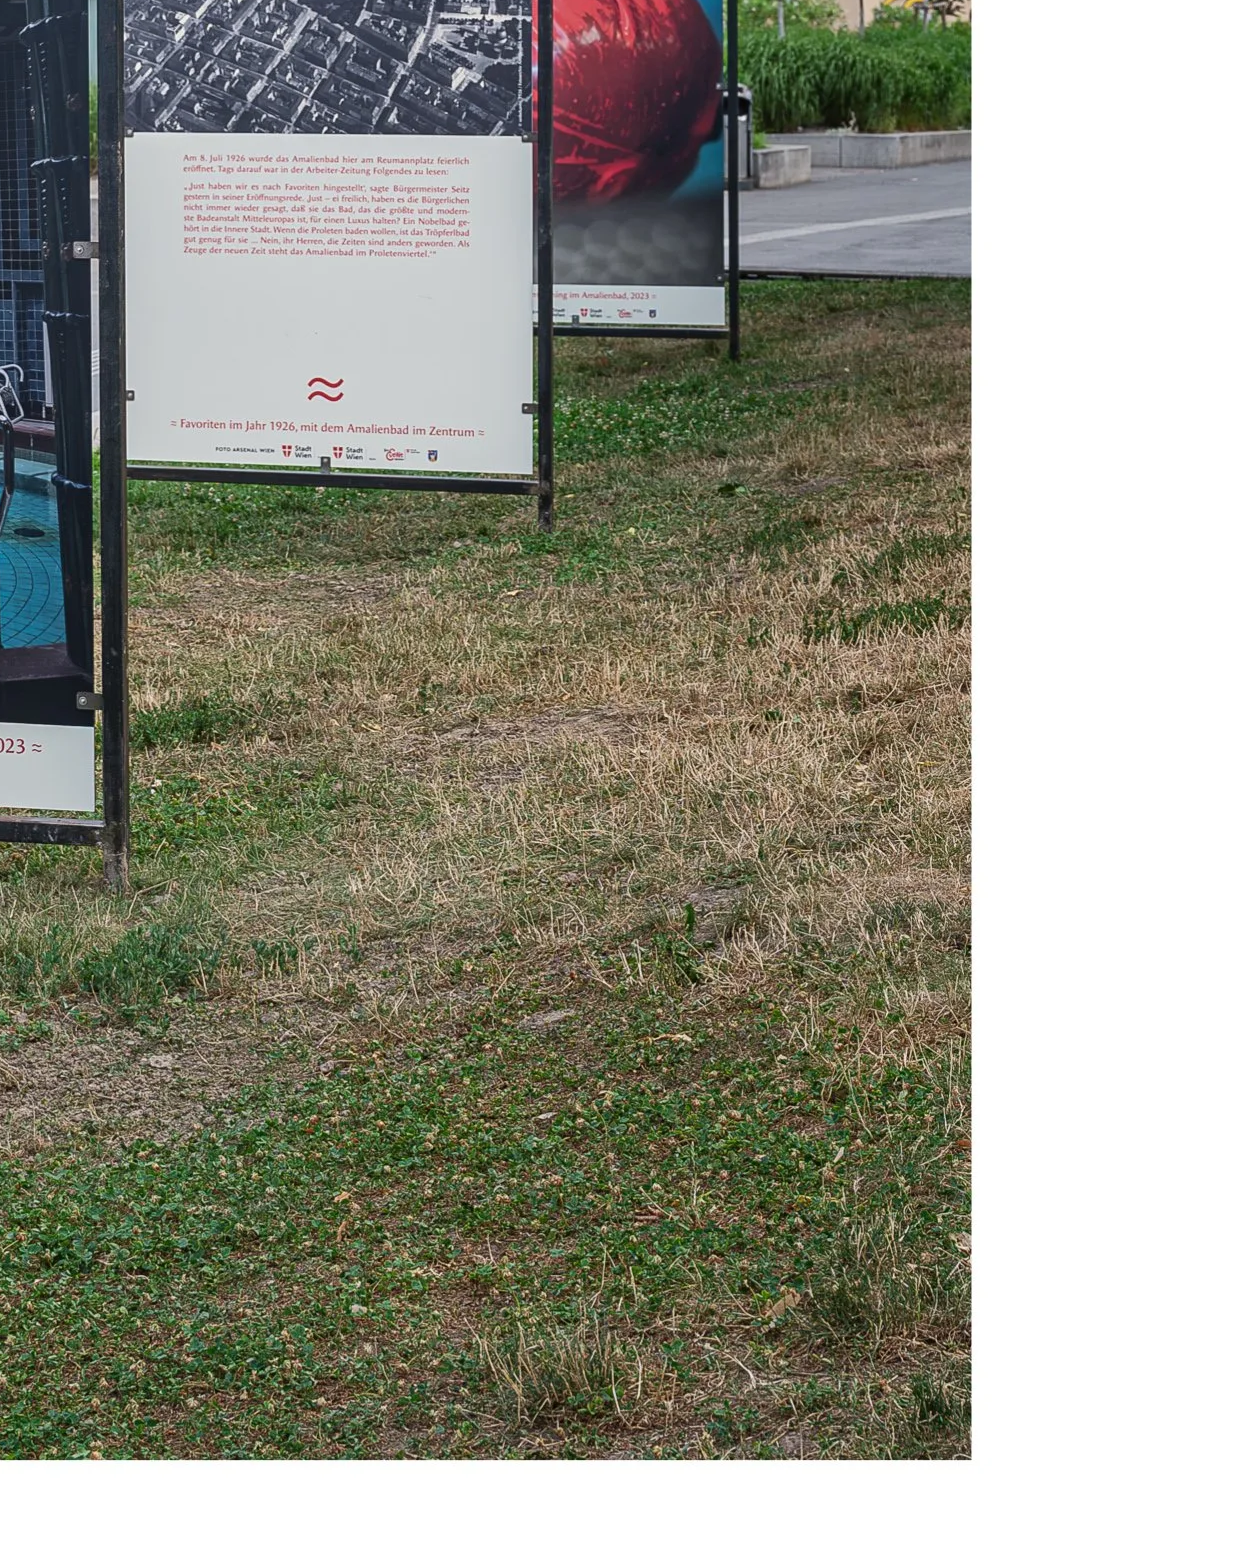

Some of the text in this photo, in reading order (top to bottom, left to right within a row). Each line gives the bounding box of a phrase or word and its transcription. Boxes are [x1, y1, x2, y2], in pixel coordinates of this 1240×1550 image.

[209, 155, 223, 163] Juli
[377, 156, 434, 166] Reumannplatz
[437, 157, 470, 165] feierlich
[218, 165, 234, 174] Tags
[306, 166, 371, 176] Arbeiter-Zeitung
[373, 167, 412, 177] Folgendes
[393, 185, 448, 194] Bürgermeister
[184, 194, 210, 202] gestern
[246, 194, 304, 203] Eröffnungsrede.
[342, 195, 369, 203] freilich,
[422, 196, 470, 206] Bürgerlichen
[184, 204, 203, 212] nicht
[234, 204, 260, 212] wieder
[338, 206, 355, 214] Bad,
[389, 206, 414, 216] größte
[242, 215, 295, 224] Mitteleuropas
[184, 237, 196, 246] gut
[198, 238, 222, 247] genug
[260, 237, 281, 245] Nein,
[415, 240, 456, 249] geworden.
[184, 246, 207, 256] Zeuge
[582, 292, 629, 300] Amalienbad,
[180, 419, 474, 437] Favoriten im Jahr 1926, mit dem Amalienbad im Zentrum
